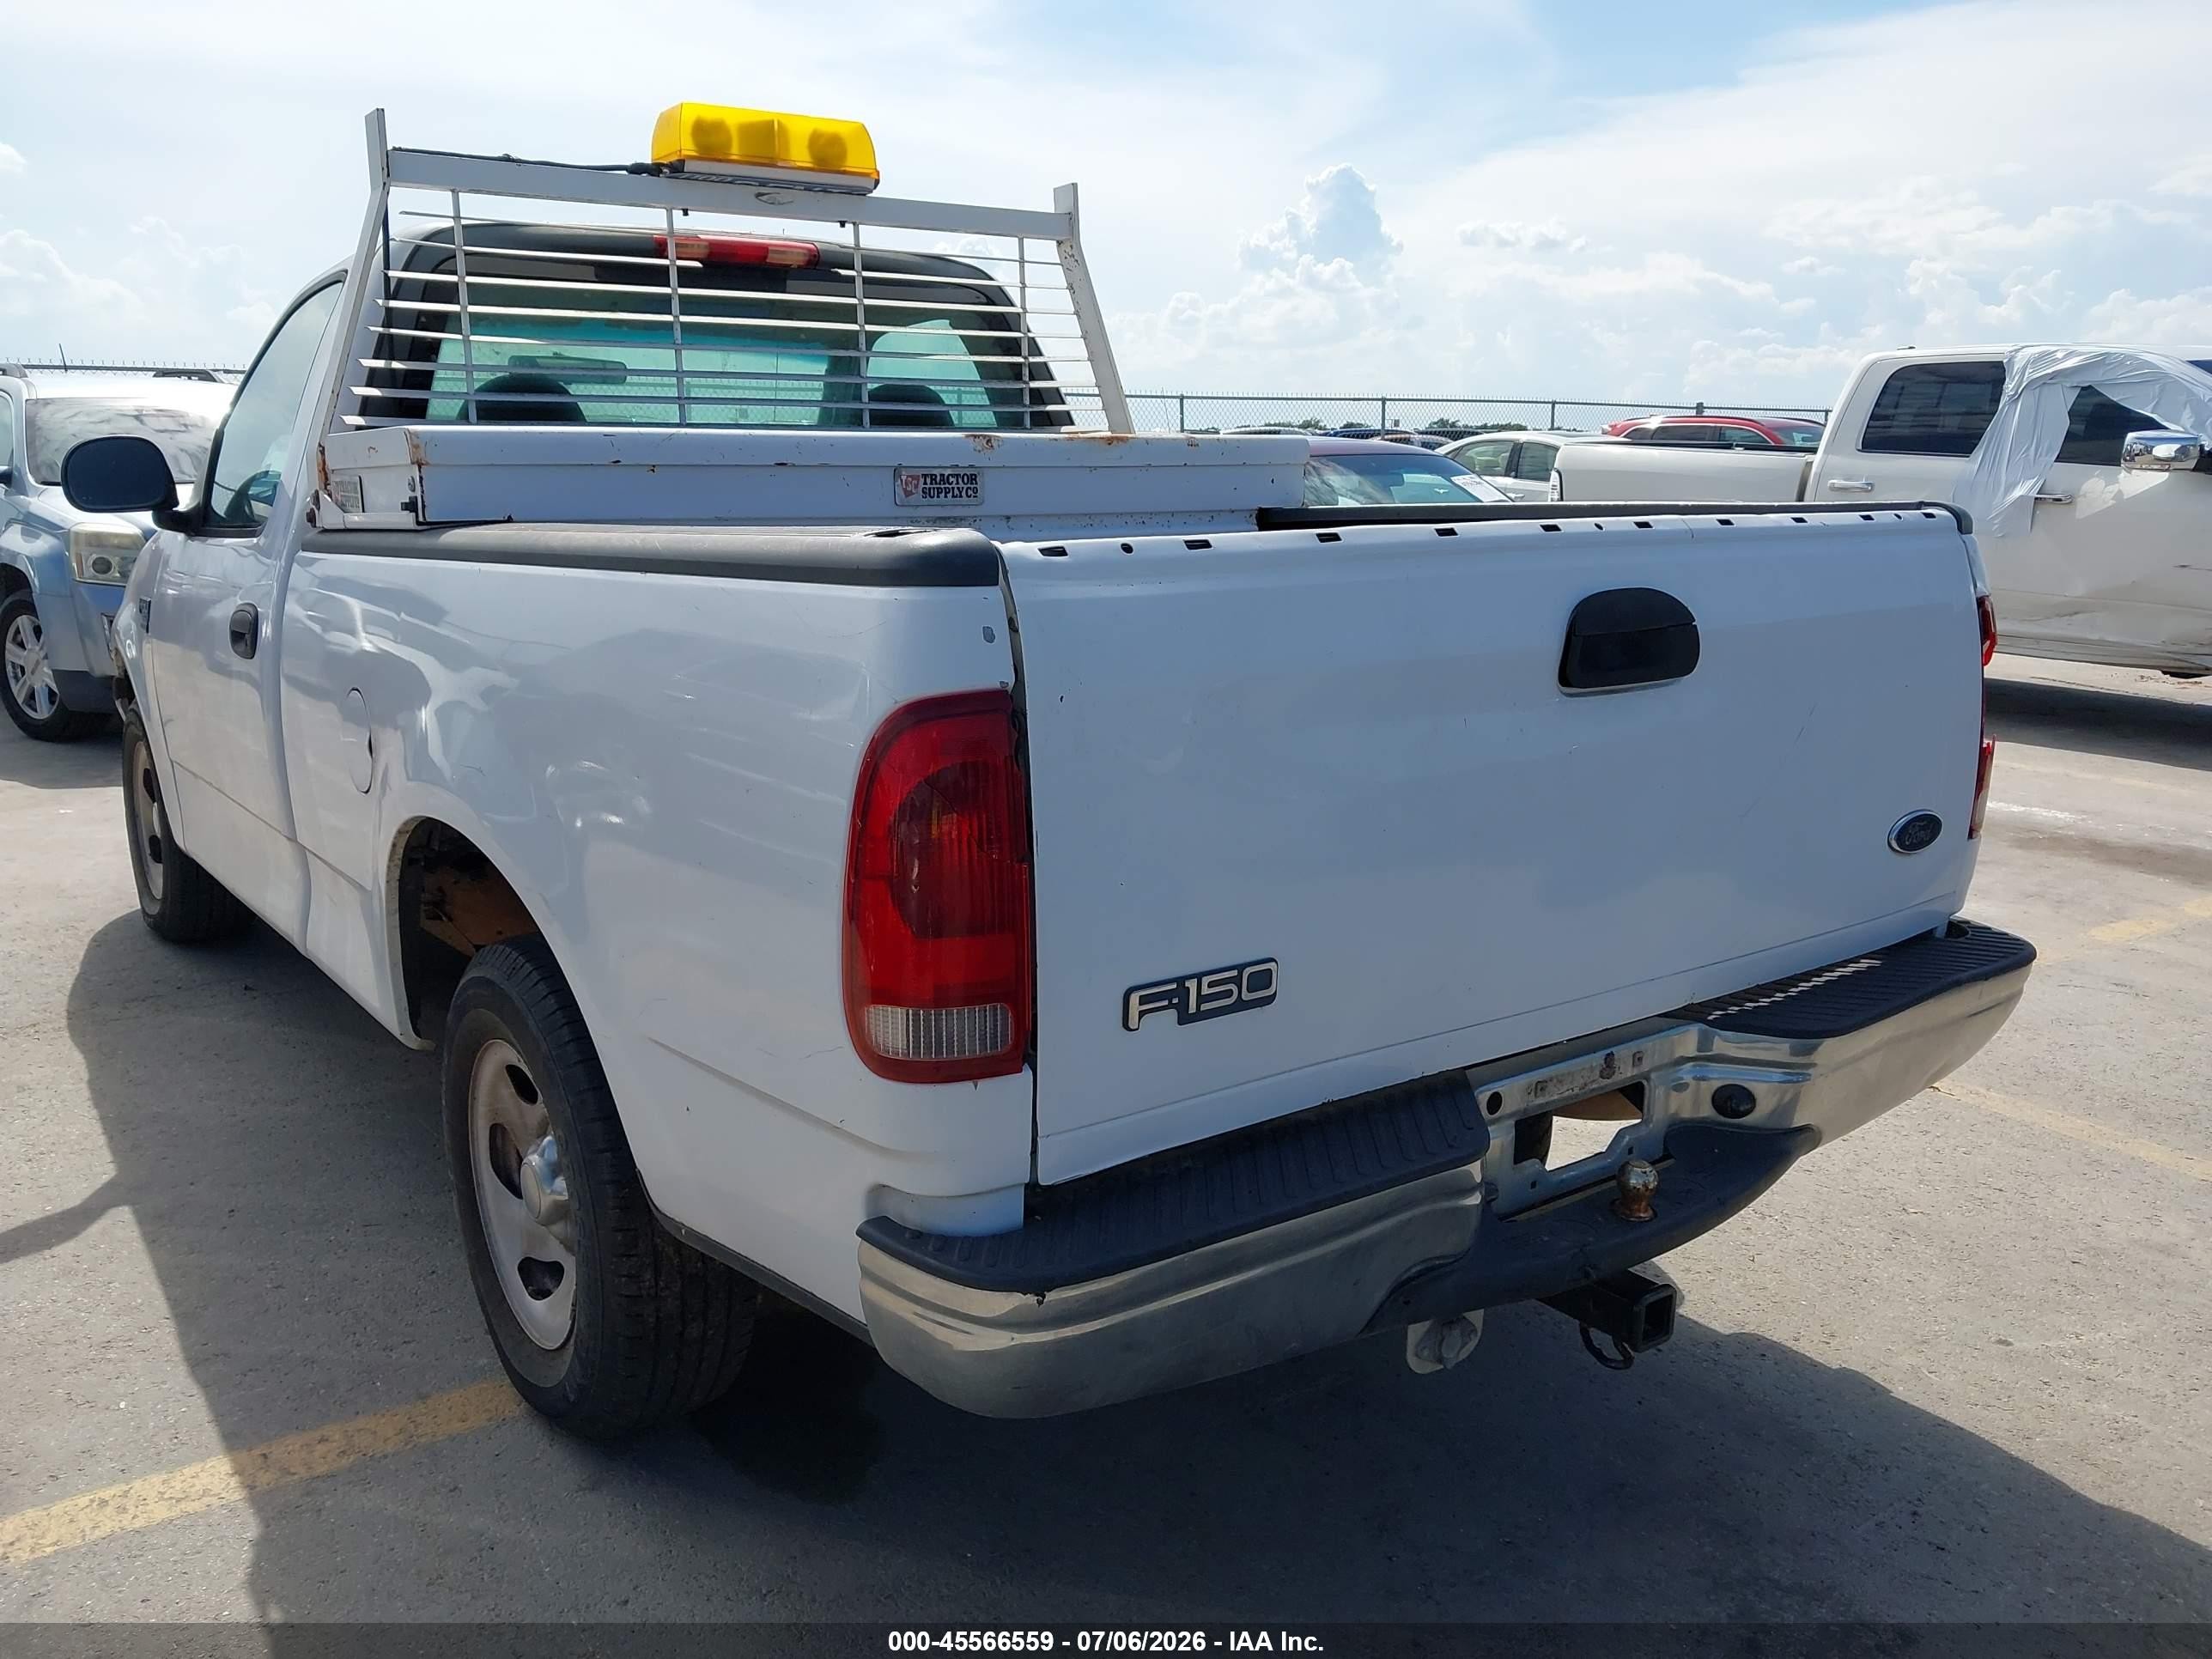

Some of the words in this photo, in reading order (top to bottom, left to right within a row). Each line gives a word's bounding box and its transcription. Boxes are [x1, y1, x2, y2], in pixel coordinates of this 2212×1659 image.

[921, 473, 978, 486] TRACTOR
[921, 487, 963, 499] SUPPLY
[1128, 961, 1279, 1030] F-150
